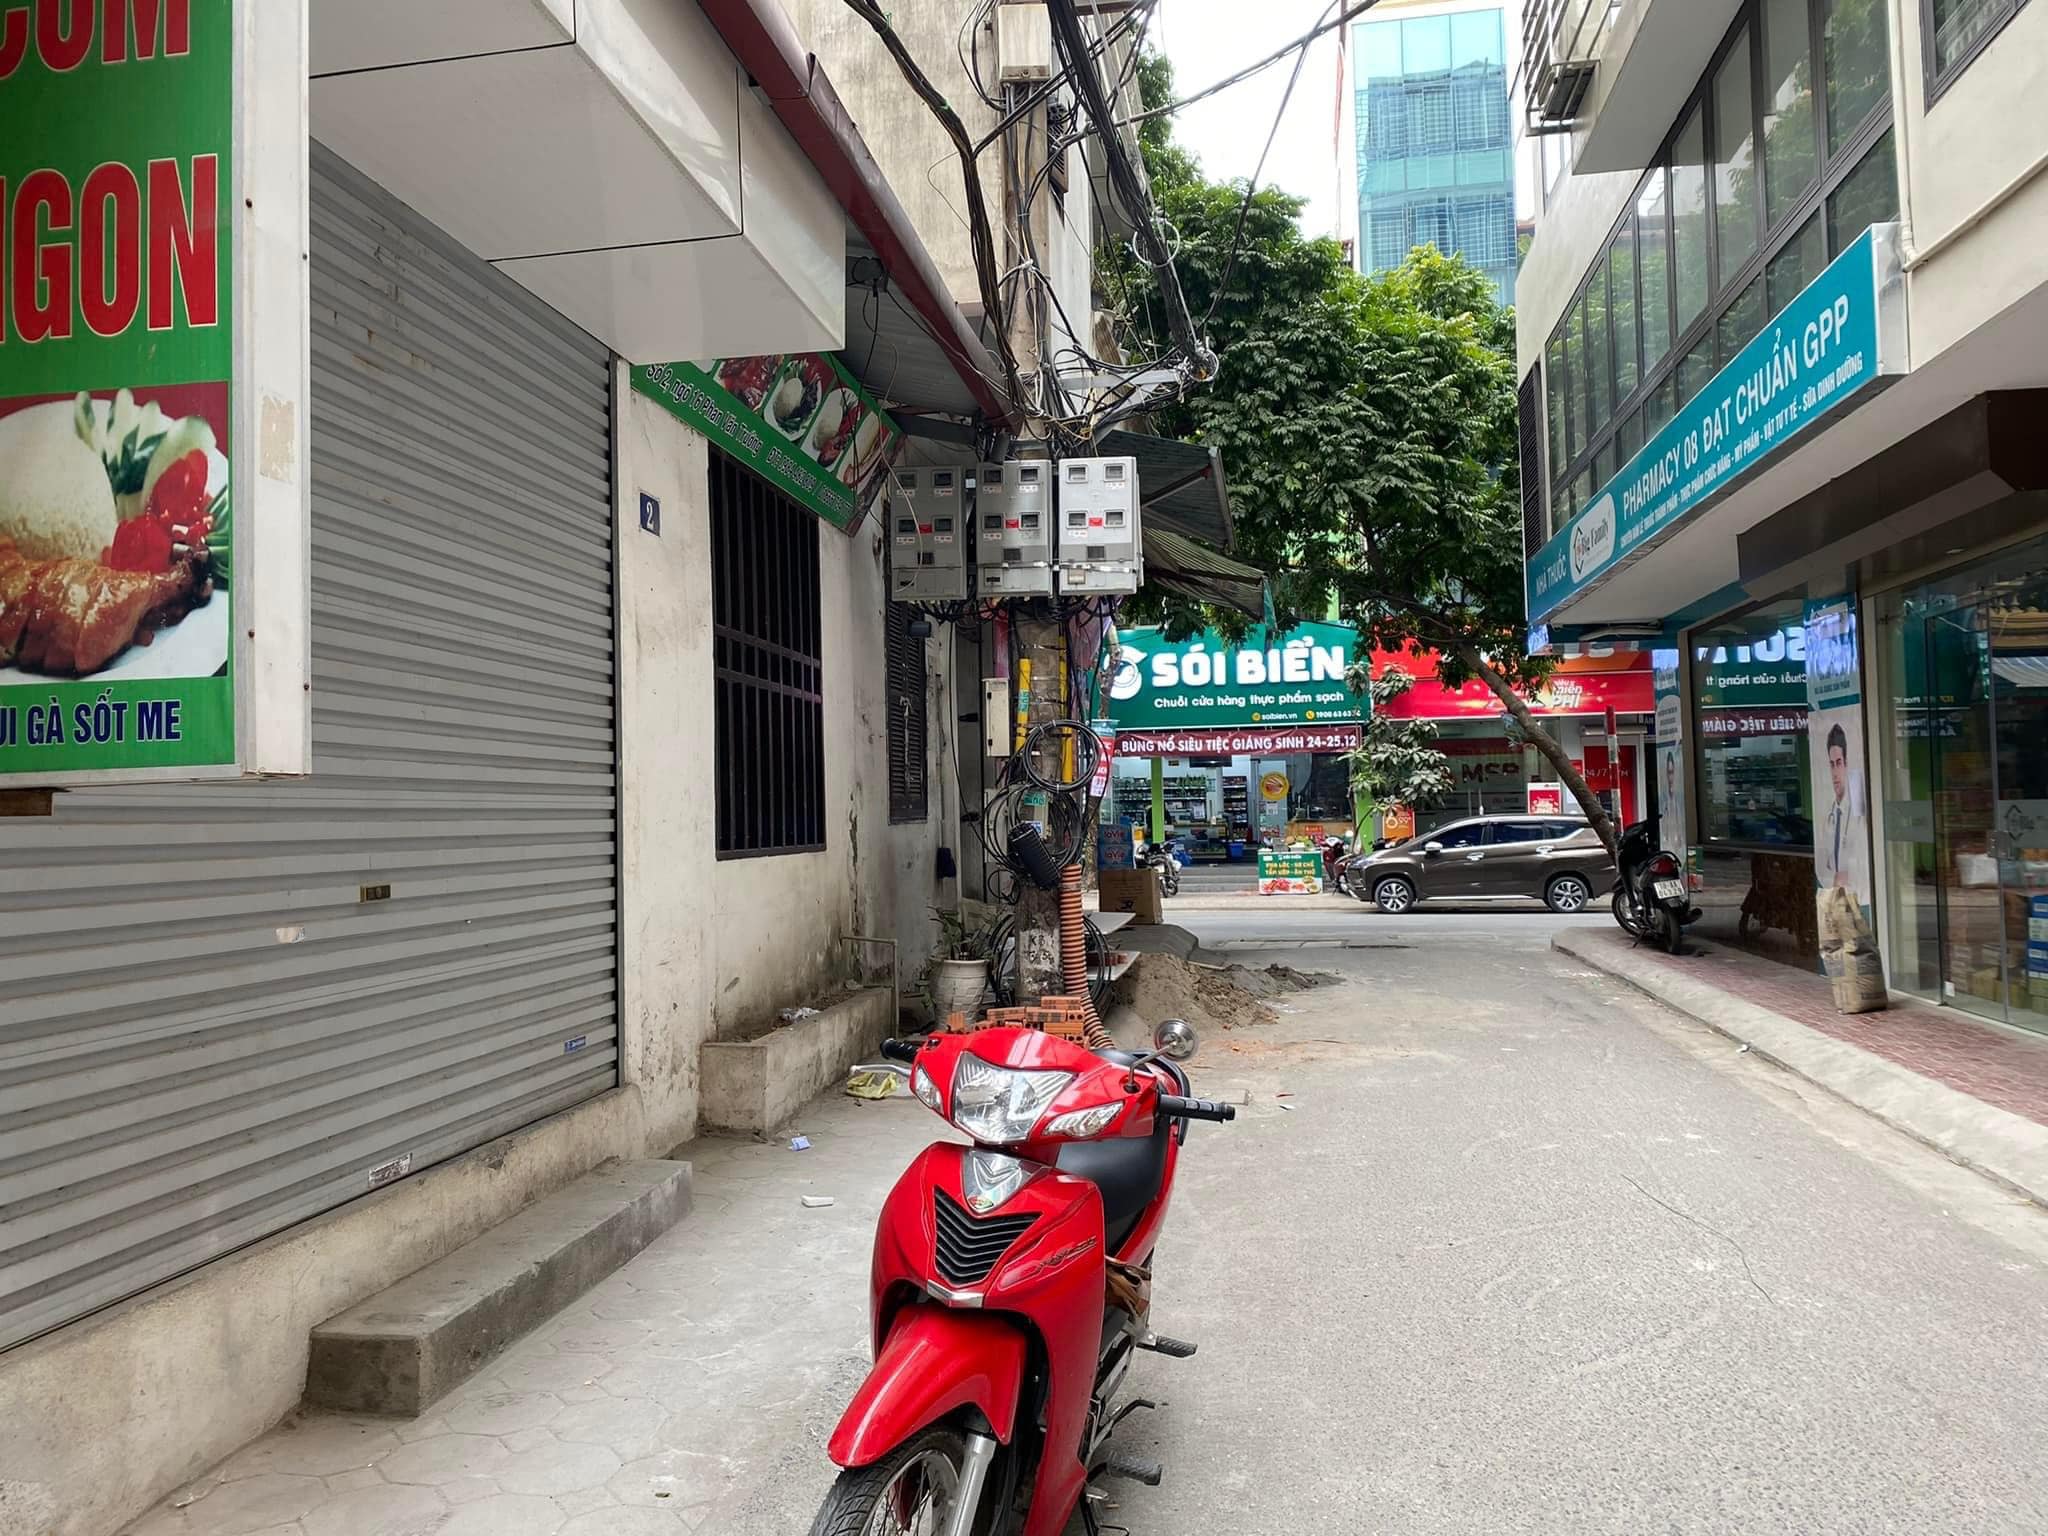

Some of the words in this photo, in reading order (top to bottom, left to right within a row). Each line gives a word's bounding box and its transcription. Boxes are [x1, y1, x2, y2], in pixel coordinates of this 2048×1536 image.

[0, 153, 218, 344] GON
[1803, 385, 1816, 412] SỮA
[1818, 372, 1835, 401] DINH
[1836, 351, 1863, 387] DƯỠNG
[689, 389, 704, 411] 16
[700, 396, 723, 426] Phan
[1623, 443, 1680, 520] PHARMACY
[1683, 430, 1698, 470] 08
[1703, 396, 1731, 453] ĐẠT
[1736, 328, 1797, 425] CHUẨN
[1804, 294, 1849, 368] GPP
[646, 501, 655, 531] 2
[1536, 567, 1547, 598] NHÀ
[1547, 548, 1567, 588] THUỐC
[1151, 643, 1227, 687] SÓI
[1236, 635, 1345, 685] BIỂN
[26, 695, 65, 746] GÀ
[72, 688, 128, 744] SỐT
[136, 699, 182, 742] ME
[1154, 695, 1188, 708] Chuỗi
[1192, 695, 1214, 705] cửa
[1217, 695, 1245, 707] hàng
[1250, 694, 1275, 706] thực
[1279, 689, 1312, 705] phẩm
[1316, 692, 1344, 704] sạch
[1262, 712, 1298, 720] soibien.vn
[1121, 738, 1154, 752] BÙNG
[1157, 734, 1176, 751] NỔ
[1179, 737, 1203, 751] SIÊU
[1206, 736, 1229, 753] TIỆC
[1232, 735, 1272, 750] GIÁNG
[1275, 736, 1304, 748] SINH
[1307, 735, 1356, 748] 24-25.12
